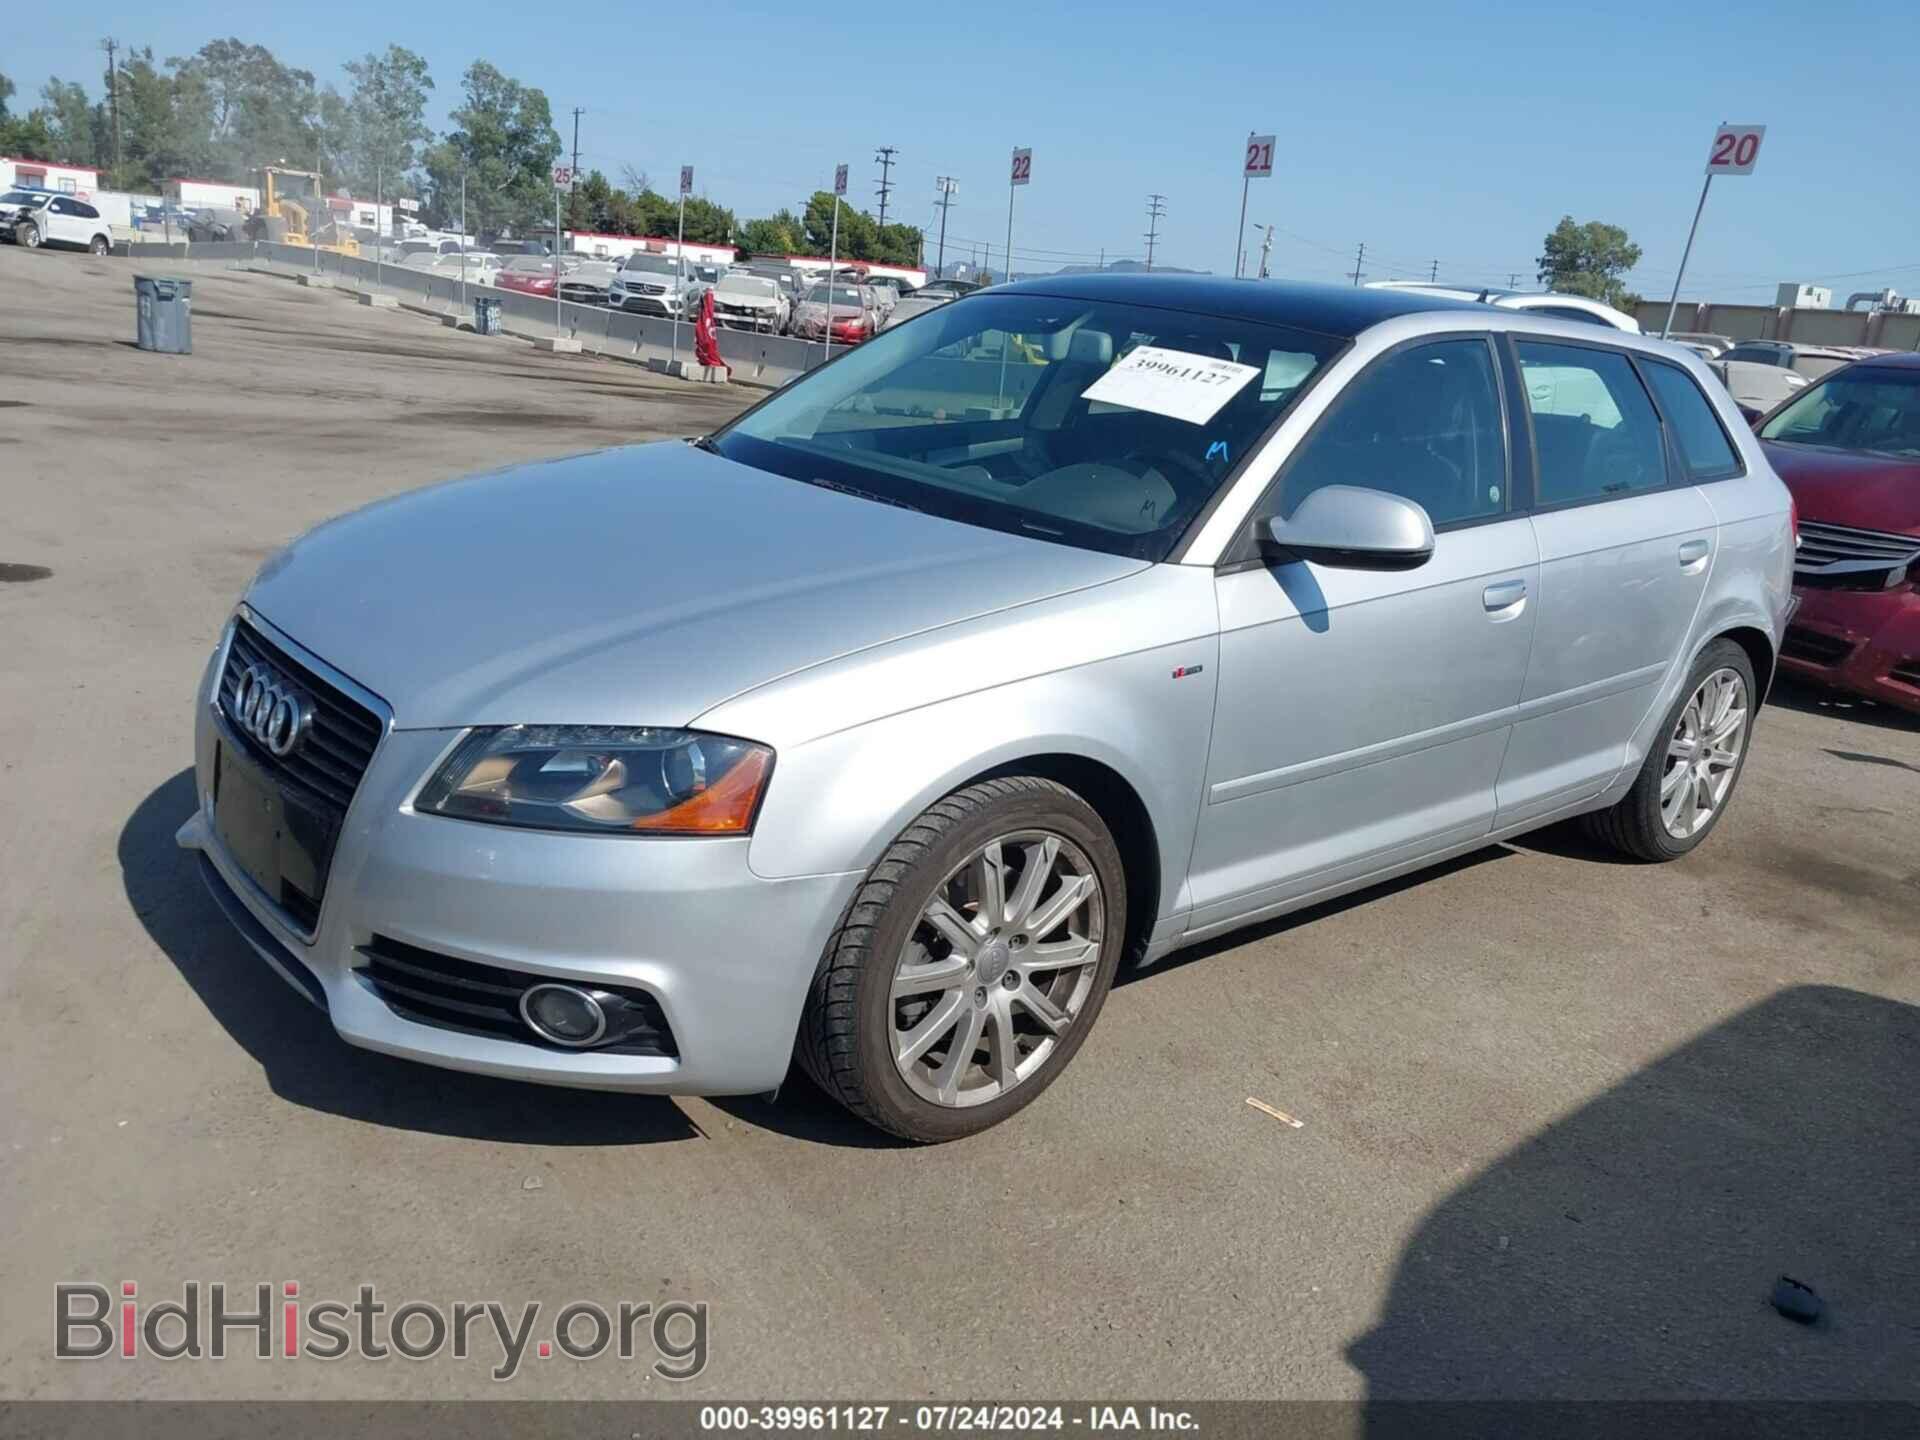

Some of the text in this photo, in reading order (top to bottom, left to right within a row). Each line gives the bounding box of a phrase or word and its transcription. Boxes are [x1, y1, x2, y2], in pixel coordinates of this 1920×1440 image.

[1246, 144, 1271, 170] 21
[1710, 134, 1759, 166] 20
[555, 167, 570, 184] 25
[1012, 156, 1031, 179] 22
[1137, 358, 1232, 386] 39961127
